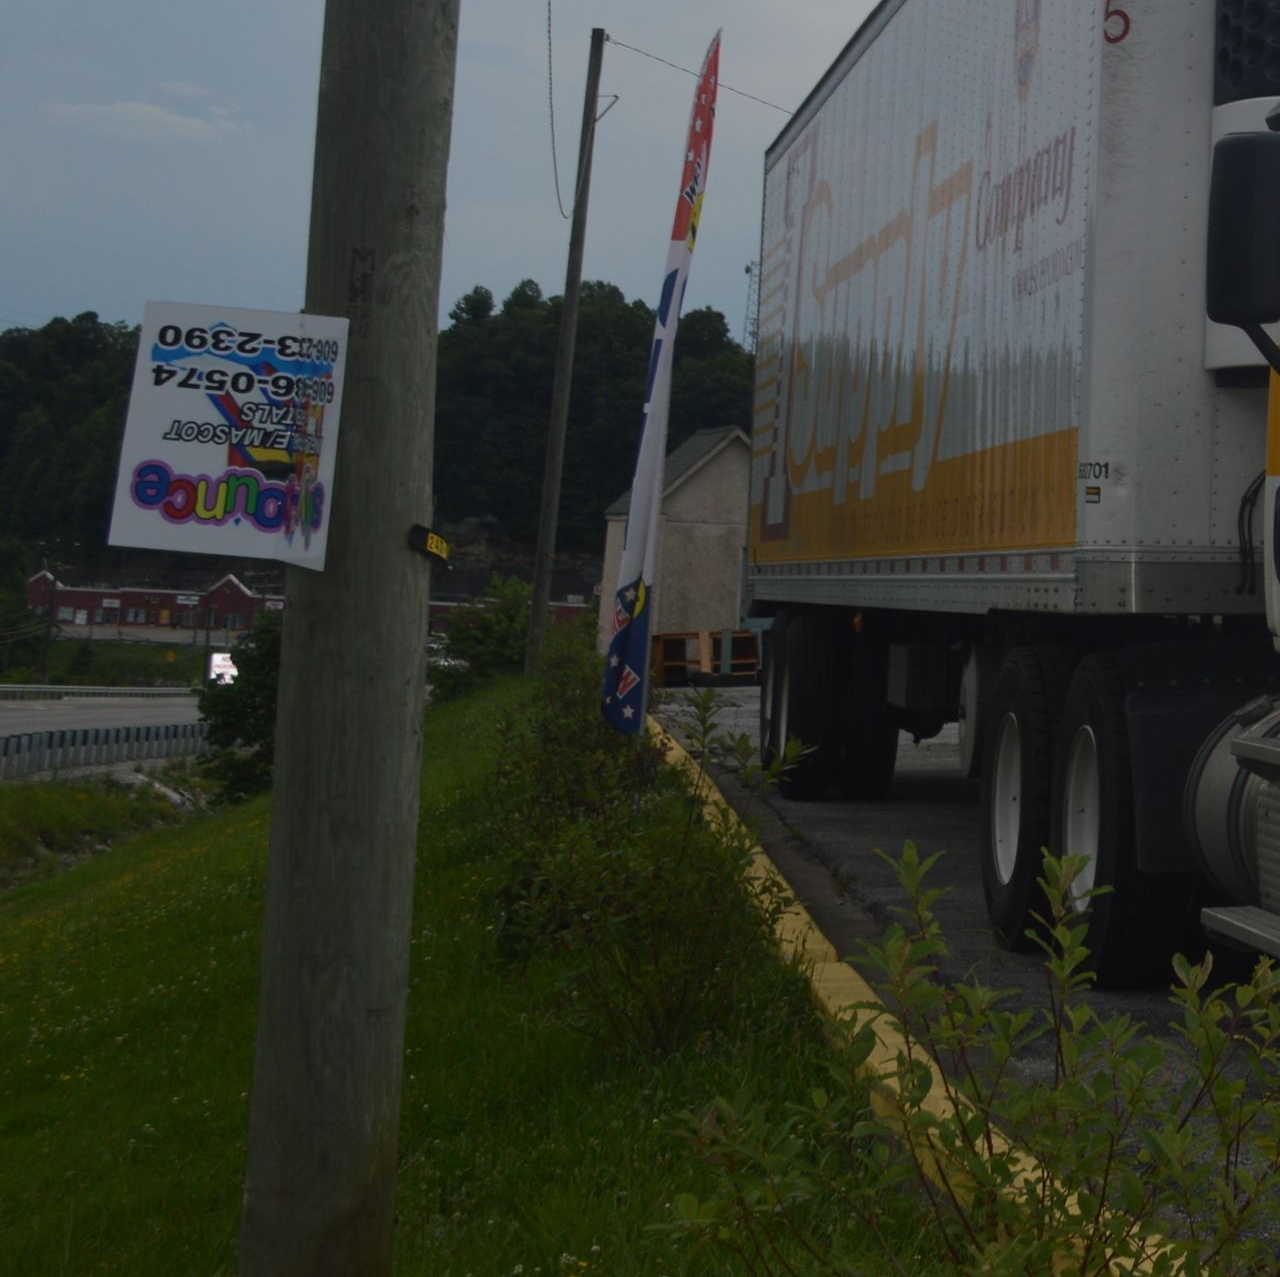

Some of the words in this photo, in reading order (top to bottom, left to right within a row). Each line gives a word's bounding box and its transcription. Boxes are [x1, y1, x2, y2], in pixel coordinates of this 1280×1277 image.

[975, 125, 1076, 252] Company
[158, 325, 339, 363] 606-233-2390
[163, 421, 264, 447] MASCOT
